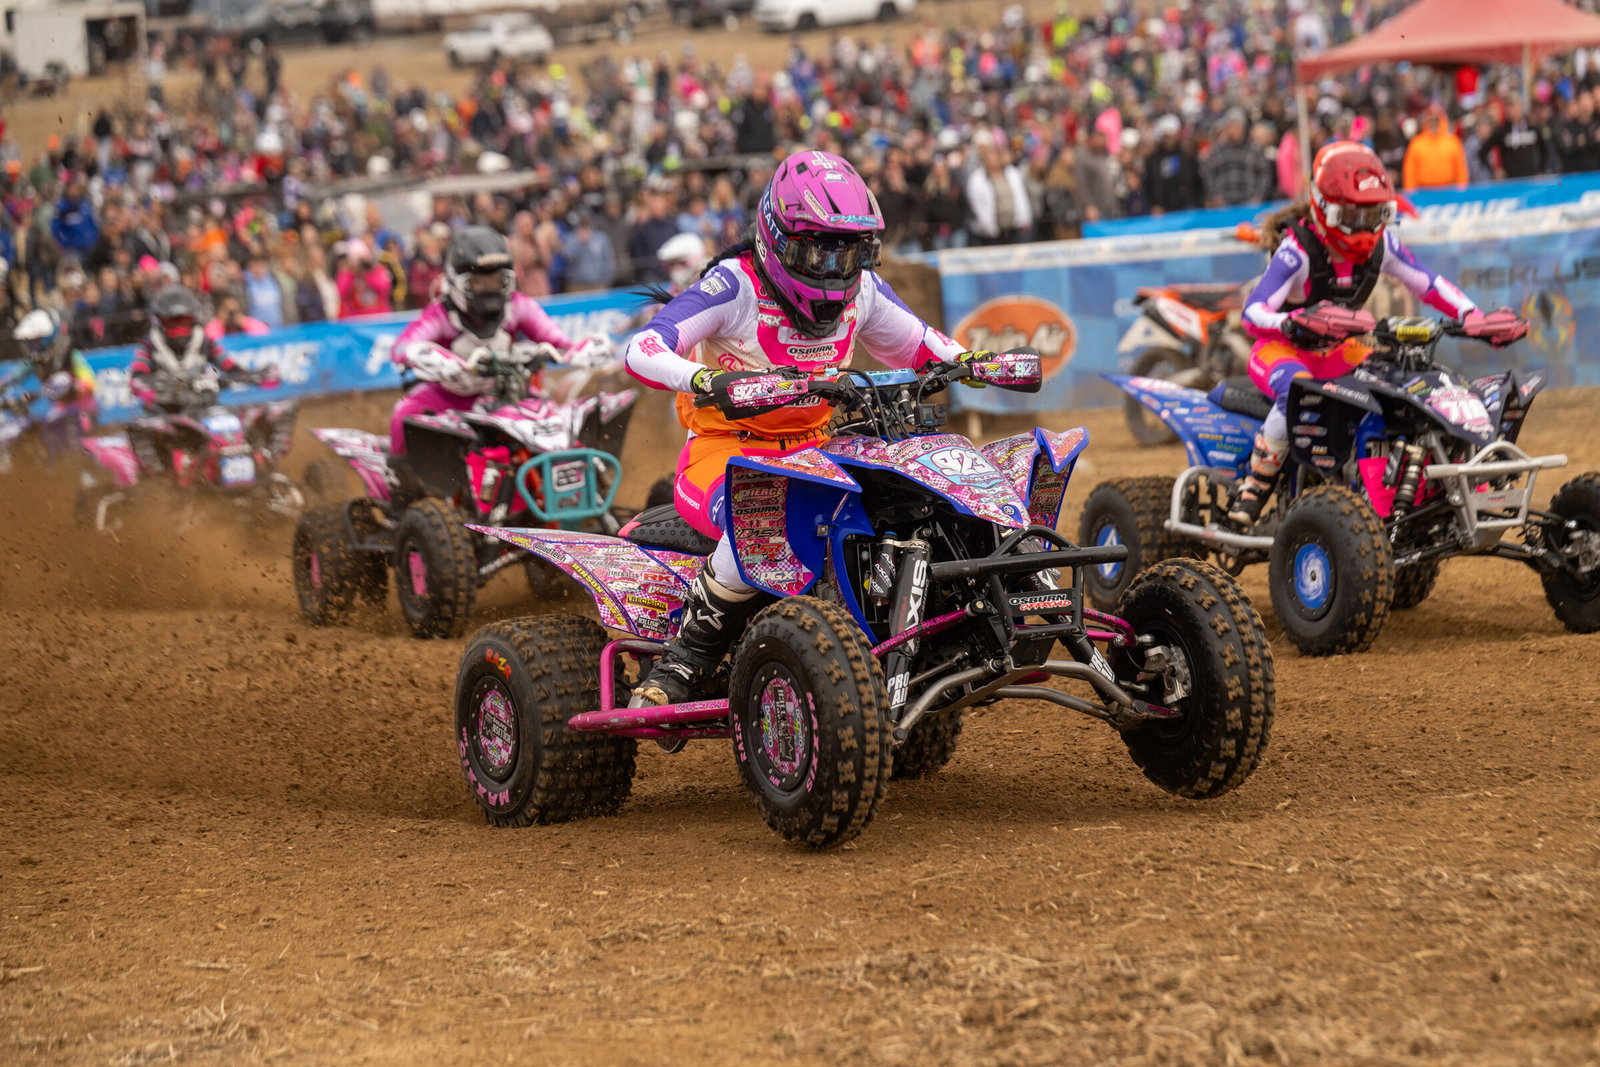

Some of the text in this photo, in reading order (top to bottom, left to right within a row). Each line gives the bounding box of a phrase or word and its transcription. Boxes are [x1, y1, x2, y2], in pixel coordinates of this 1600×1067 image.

[762, 189, 783, 240] LEATT
[757, 313, 782, 326] PGX
[1029, 322, 1070, 356] Air
[789, 345, 833, 355] OSBURN
[1015, 361, 1040, 376] 923
[733, 383, 762, 401] 923
[931, 448, 996, 476] 923
[740, 487, 784, 501] PIERCE
[735, 506, 780, 516] OSBURN
[533, 541, 567, 562] QuadTech
[571, 562, 604, 593] HINSON
[643, 572, 672, 583] RK
[760, 570, 798, 583] PGX
[1009, 594, 1067, 606] OSBURN
[1020, 600, 1072, 611] OFFROAD
[485, 648, 512, 680] RAZR
[887, 671, 910, 693] PRO
[805, 691, 820, 793] MAXXIS
[458, 740, 511, 806] MAXXIS
